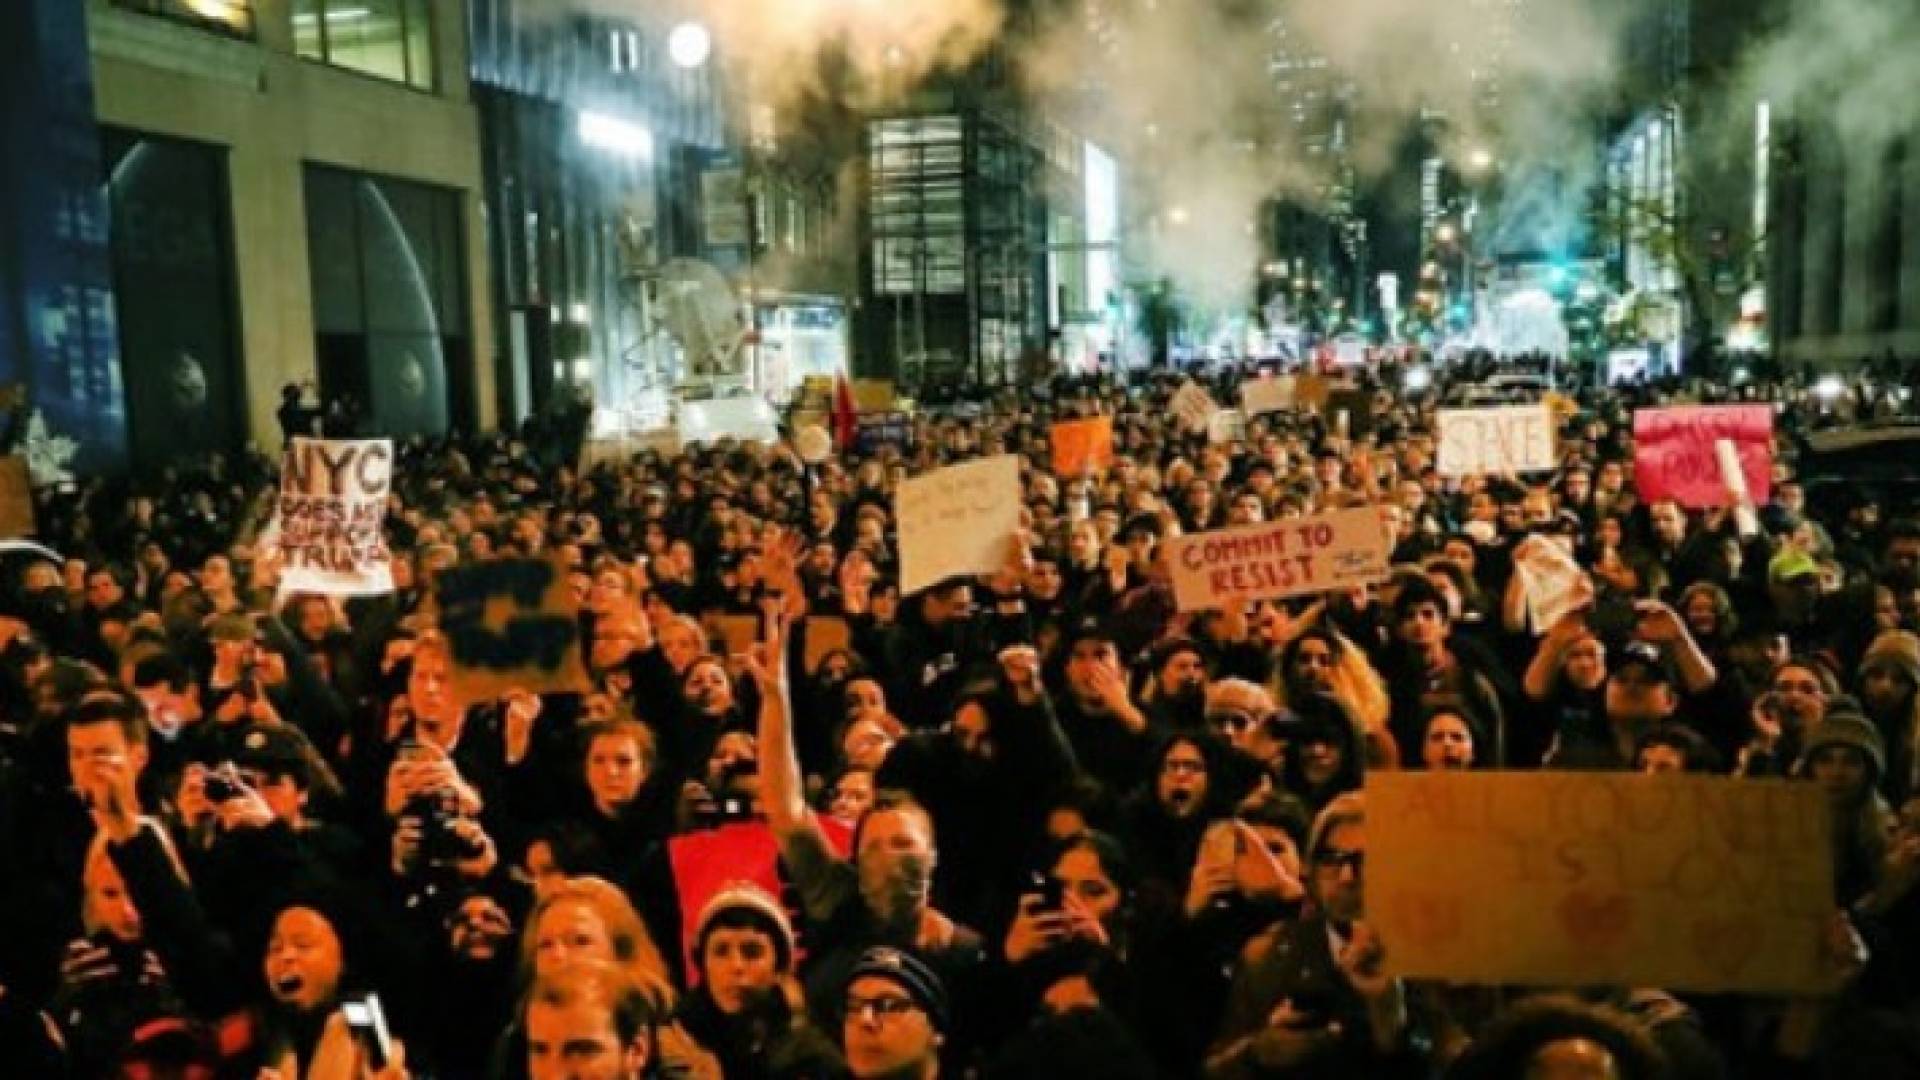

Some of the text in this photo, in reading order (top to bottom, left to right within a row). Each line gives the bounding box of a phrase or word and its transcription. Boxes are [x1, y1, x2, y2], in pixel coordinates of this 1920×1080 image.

[282, 441, 386, 494] NYC
[1181, 522, 1335, 570] COMMIT TO
[1210, 554, 1312, 596] RESIST
[1510, 839, 1829, 925] IS LOVE
